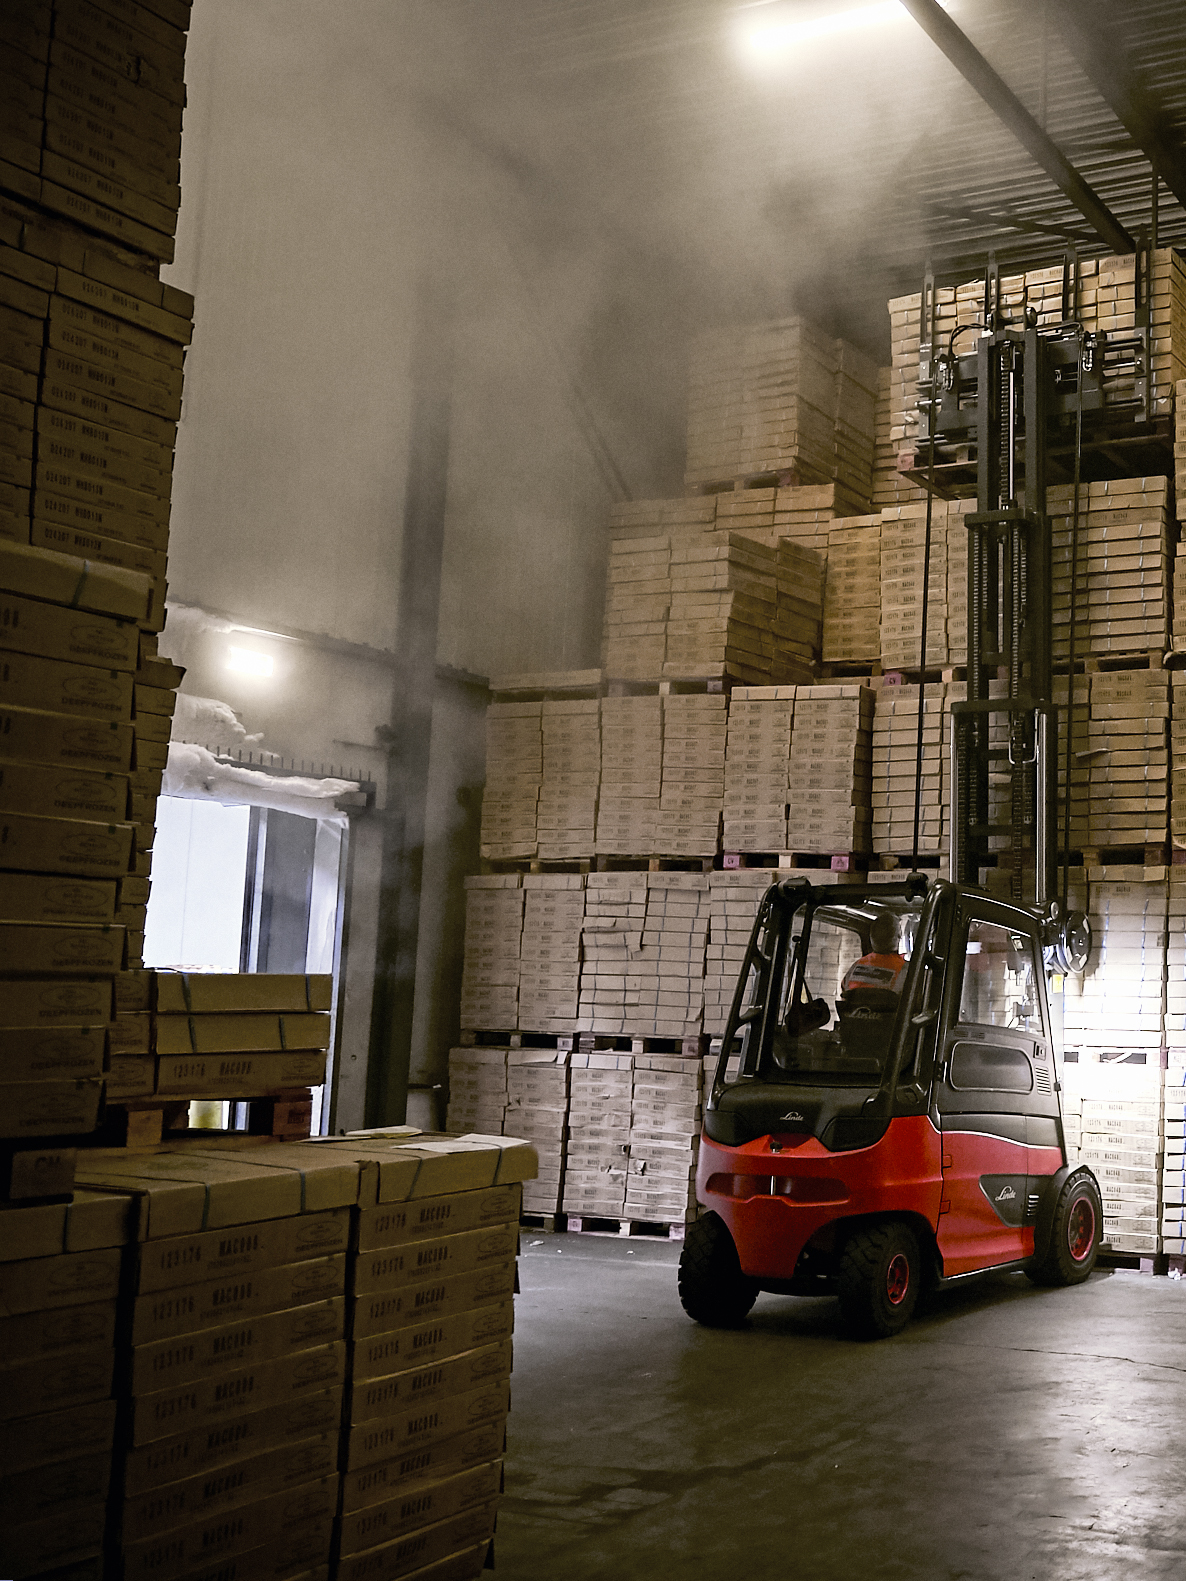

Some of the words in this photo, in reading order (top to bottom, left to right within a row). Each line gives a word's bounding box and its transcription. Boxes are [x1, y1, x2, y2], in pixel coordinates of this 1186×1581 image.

[780, 1111, 804, 1121] Linde
[995, 1186, 1016, 1201] Linde
[161, 1246, 201, 1269] 123176
[372, 1256, 404, 1276] 123176
[153, 1296, 194, 1322] 123176
[370, 1298, 401, 1318] 123176
[153, 1345, 194, 1371] 123176
[370, 1341, 399, 1362] 123176
